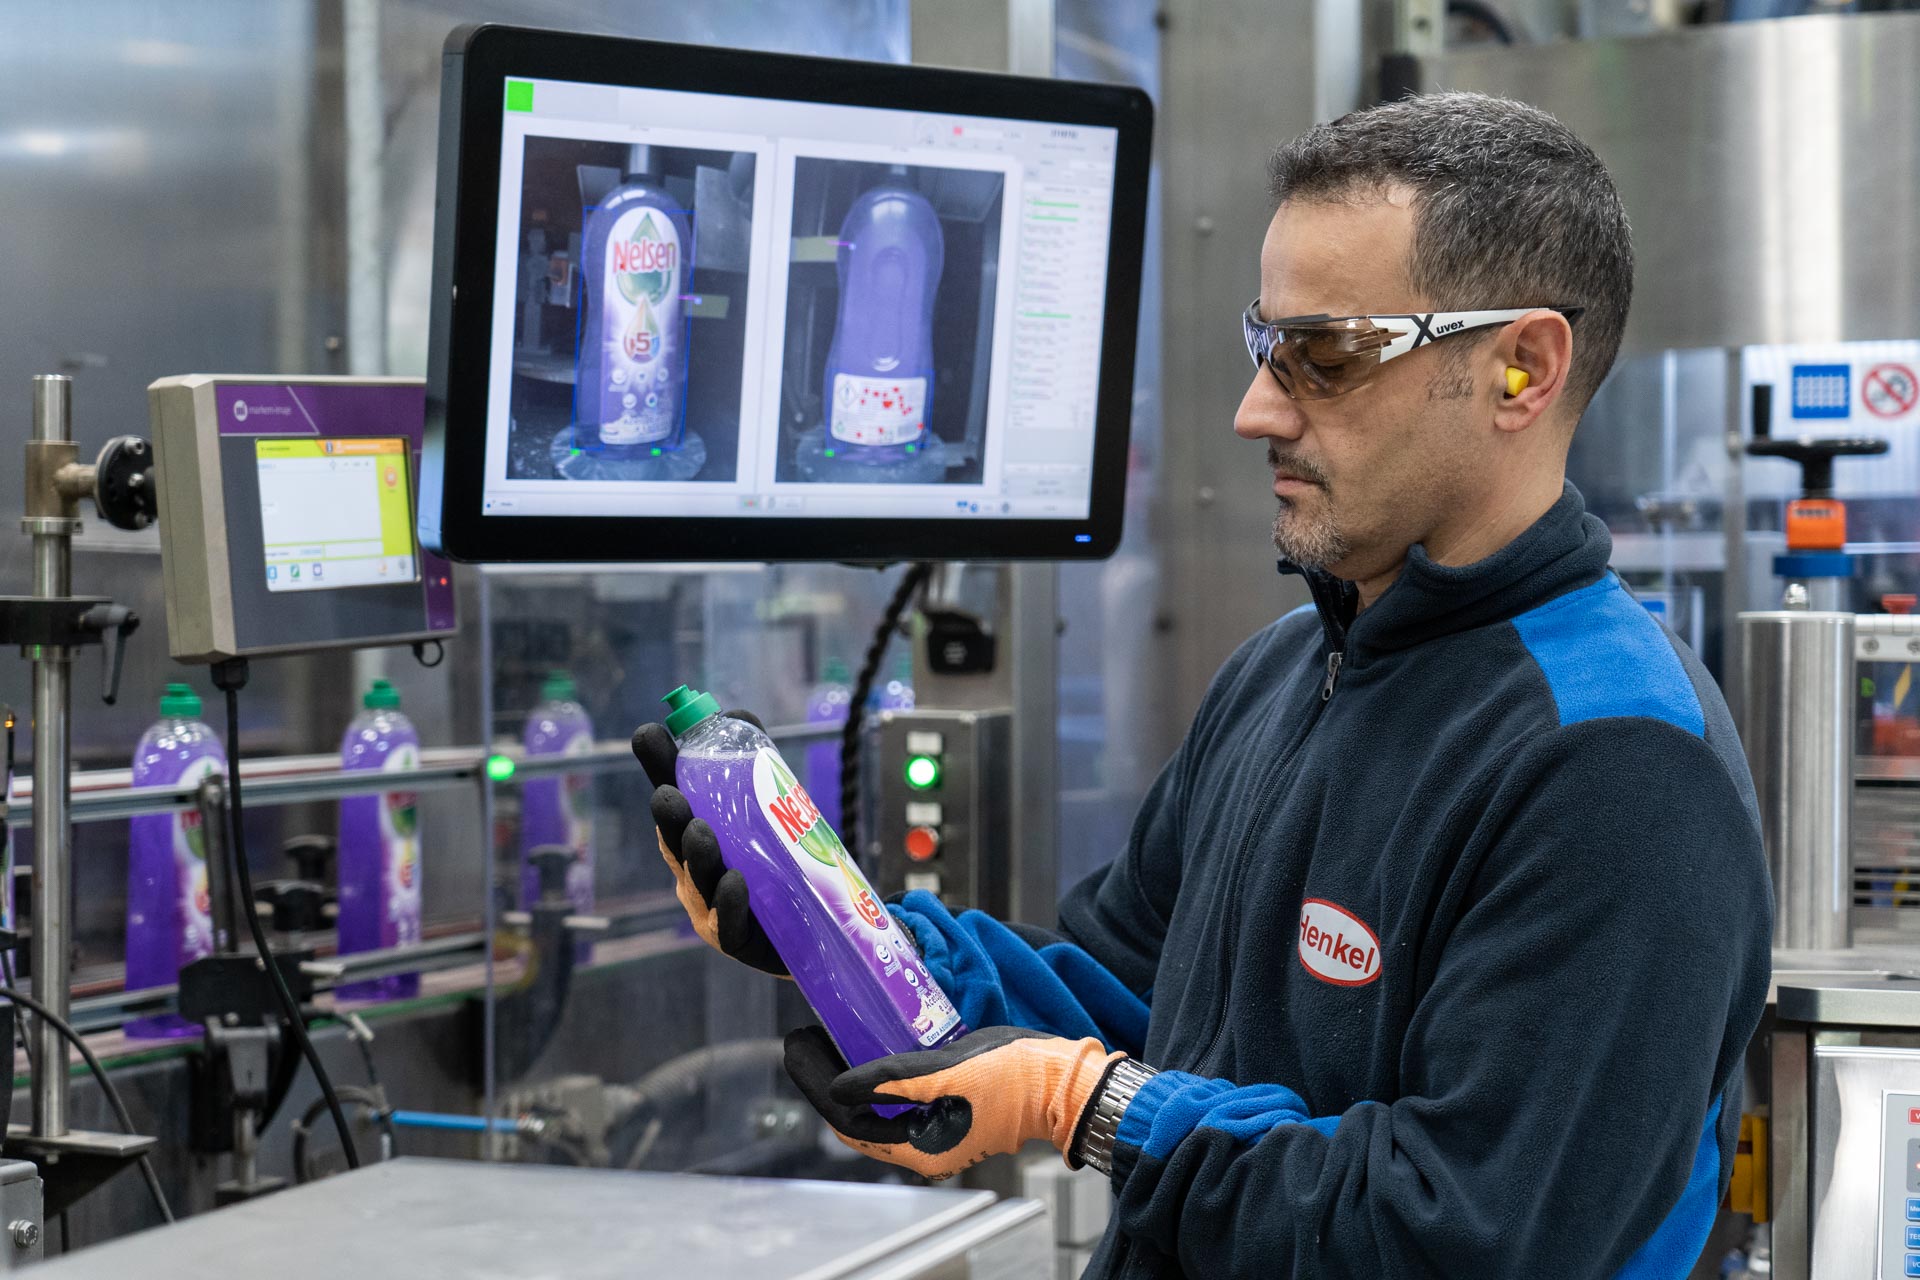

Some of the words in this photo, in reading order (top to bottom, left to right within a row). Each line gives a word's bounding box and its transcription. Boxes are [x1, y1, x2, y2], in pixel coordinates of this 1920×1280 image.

[613, 239, 676, 273] Nelsen
[1436, 320, 1465, 335] uvex
[769, 783, 820, 843] Nelse
